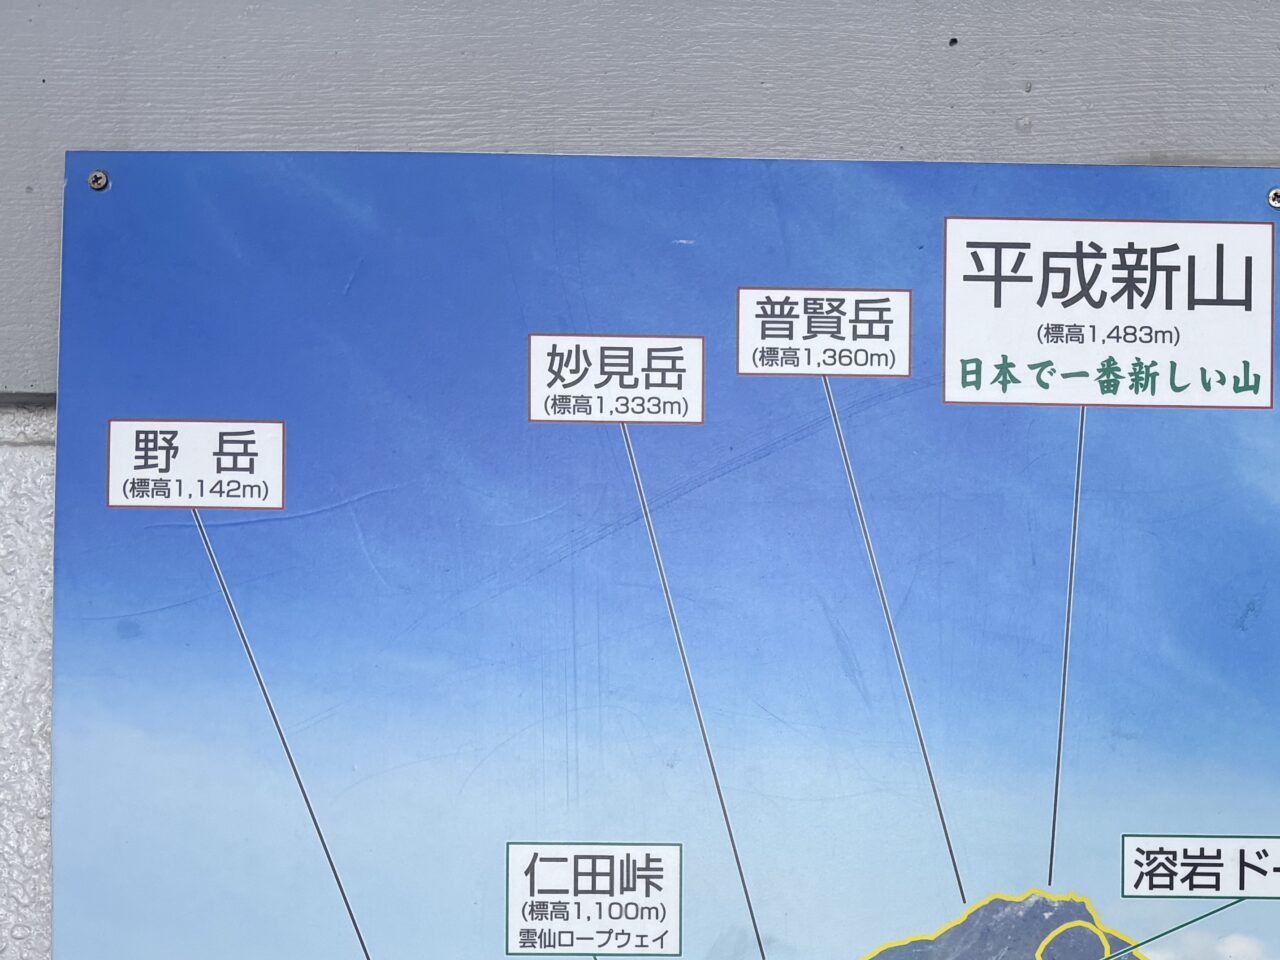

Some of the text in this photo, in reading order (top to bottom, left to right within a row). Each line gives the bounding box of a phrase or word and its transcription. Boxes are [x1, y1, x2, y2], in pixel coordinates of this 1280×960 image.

[962, 239, 1253, 313] 平成新山
[755, 295, 894, 342] 普賢岳
[1037, 323, 1181, 347] (標高1,483m)
[546, 343, 687, 391] 妙見岳
[752, 346, 896, 370] (標高1,360m)
[959, 354, 1262, 397] 日本で一番新しい山
[542, 394, 689, 419] (標高1,333m)
[121, 477, 269, 502] (標高1,142m)
[523, 852, 664, 898] 仁田峠
[521, 900, 666, 923] (標高1,100m)
[519, 928, 669, 949] 雲仙ロープウェイ
